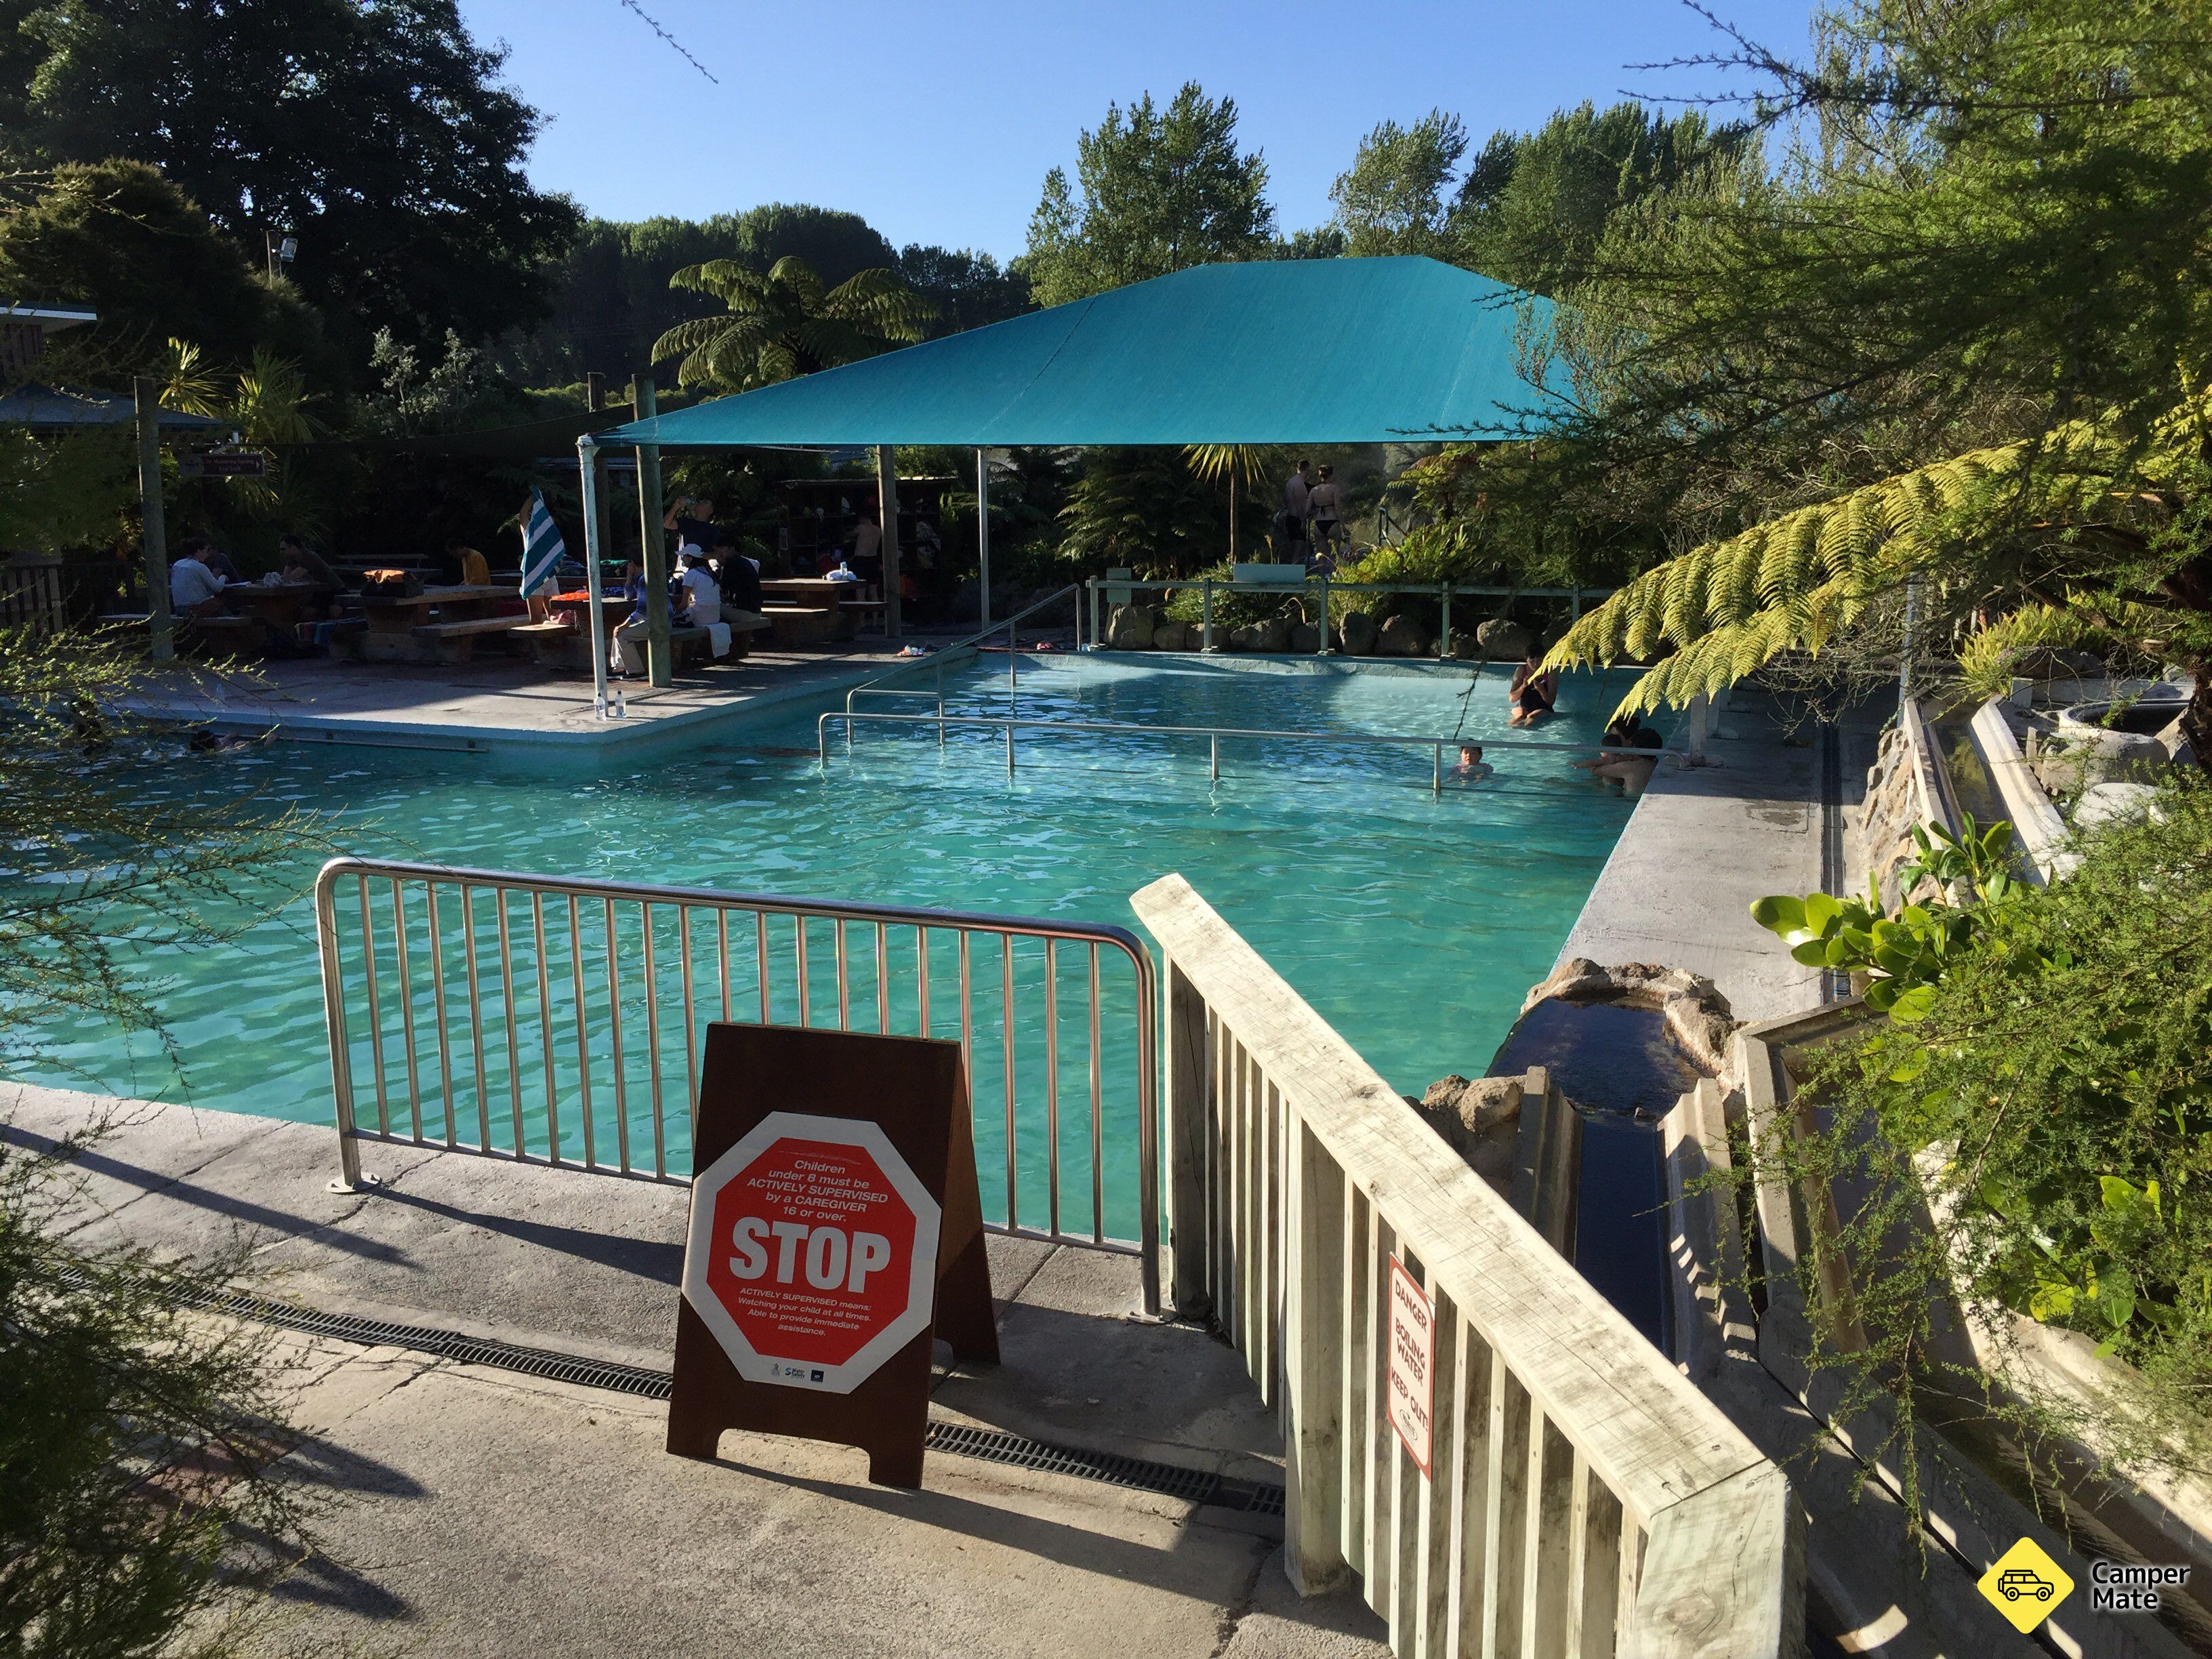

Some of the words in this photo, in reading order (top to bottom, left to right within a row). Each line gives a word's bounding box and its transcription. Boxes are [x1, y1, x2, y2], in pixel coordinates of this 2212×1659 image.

[794, 1160, 846, 1174] Children
[747, 1178, 806, 1193] ACTIVELY
[808, 1185, 888, 1204] SUPERVISED
[769, 1170, 804, 1181] under
[806, 1173, 816, 1183] 8
[819, 1176, 851, 1187] must
[853, 1179, 869, 1189] be
[765, 1191, 781, 1204] by
[783, 1195, 792, 1204] a
[795, 1195, 867, 1213] CAREGIVER
[783, 1206, 796, 1216] 16
[800, 1209, 813, 1218] or
[816, 1211, 846, 1222] over.
[729, 1216, 891, 1294] STOP
[738, 1297, 777, 1310] Watching
[779, 1303, 798, 1311] your
[800, 1306, 820, 1315] child
[846, 1312, 872, 1322] times.
[740, 1288, 781, 1299] ACTIVELY
[782, 1293, 838, 1307] SUPERVISED
[839, 1301, 872, 1311] means:
[1395, 1278, 1427, 1333] DANGER
[747, 1309, 767, 1317] Able
[779, 1313, 813, 1324] provide
[814, 1318, 860, 1330] immediate
[777, 1324, 826, 1336] assistance.
[1396, 1316, 1425, 1370] BOILING
[1397, 1337, 1423, 1387] WATER
[1391, 1366, 1408, 1400] KEEP
